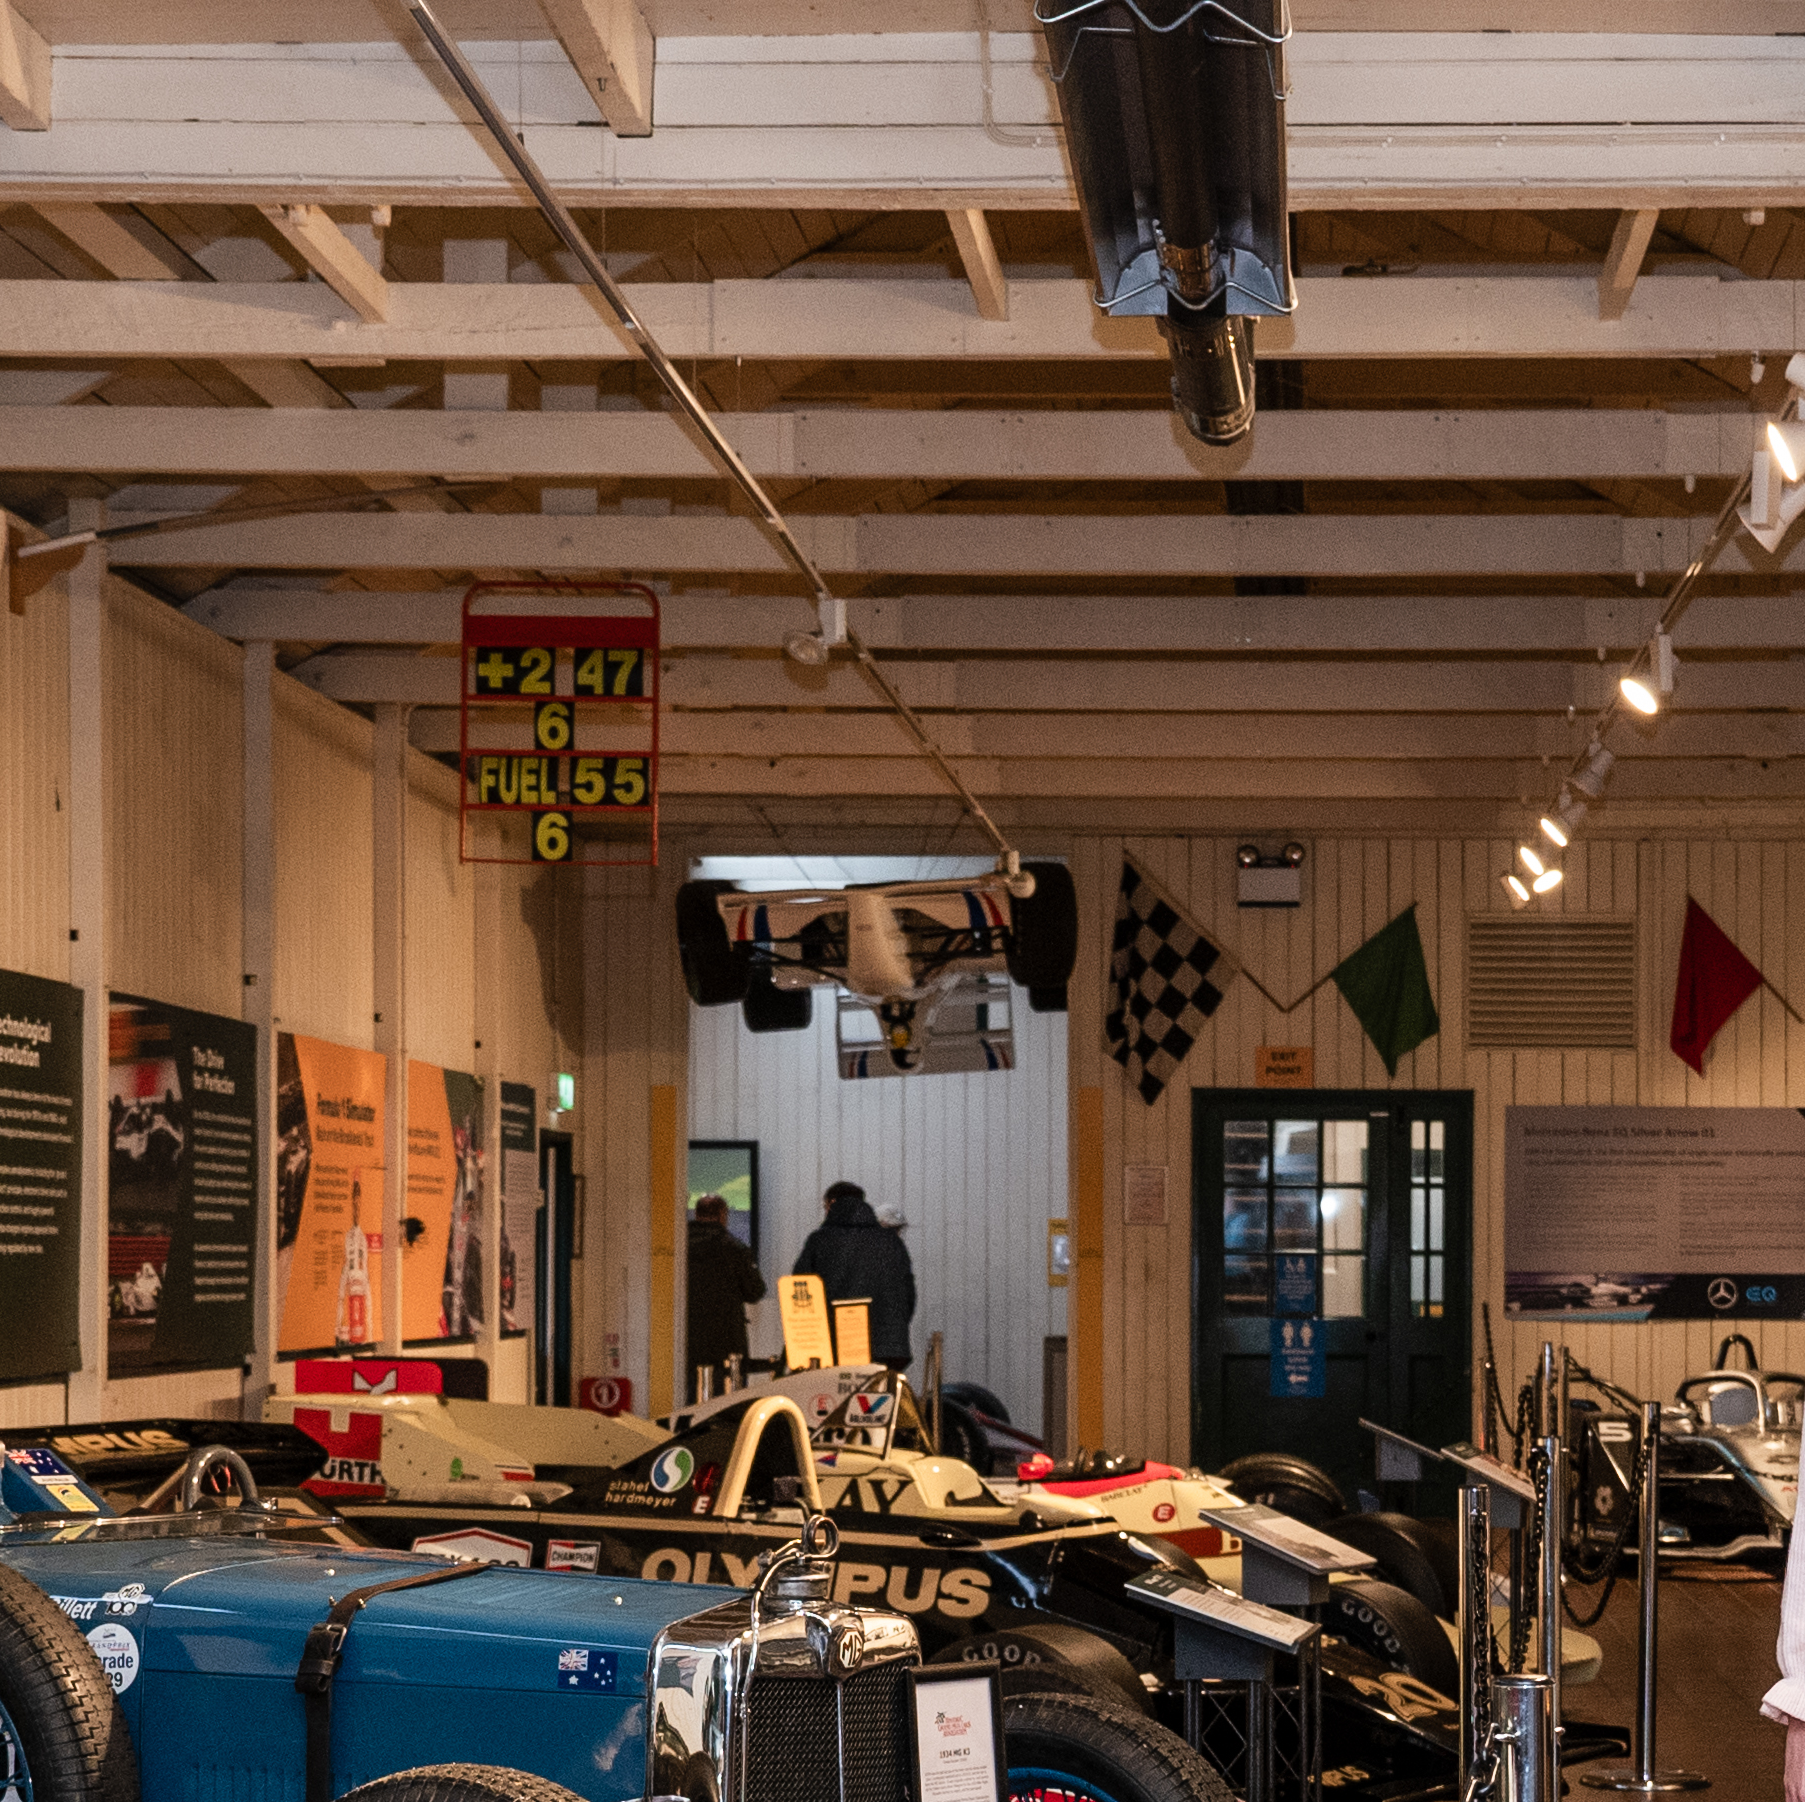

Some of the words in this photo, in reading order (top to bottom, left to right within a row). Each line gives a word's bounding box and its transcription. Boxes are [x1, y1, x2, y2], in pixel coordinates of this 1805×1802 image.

[536, 701, 571, 750] 6
[479, 756, 557, 805] FUEL
[572, 757, 646, 806] 55
[535, 811, 570, 861] 6
[1745, 1286, 1777, 1302] EQ
[317, 1457, 386, 1486] ÜRTH
[604, 1491, 677, 1508] hardmeyer
[1158, 1505, 1172, 1520] E
[551, 1548, 595, 1563] CHAMPION
[641, 1548, 992, 1619] OLYPUS
[54, 1597, 99, 1621] illett
[99, 1652, 134, 1669] rade
[840, 1634, 863, 1667] MG
